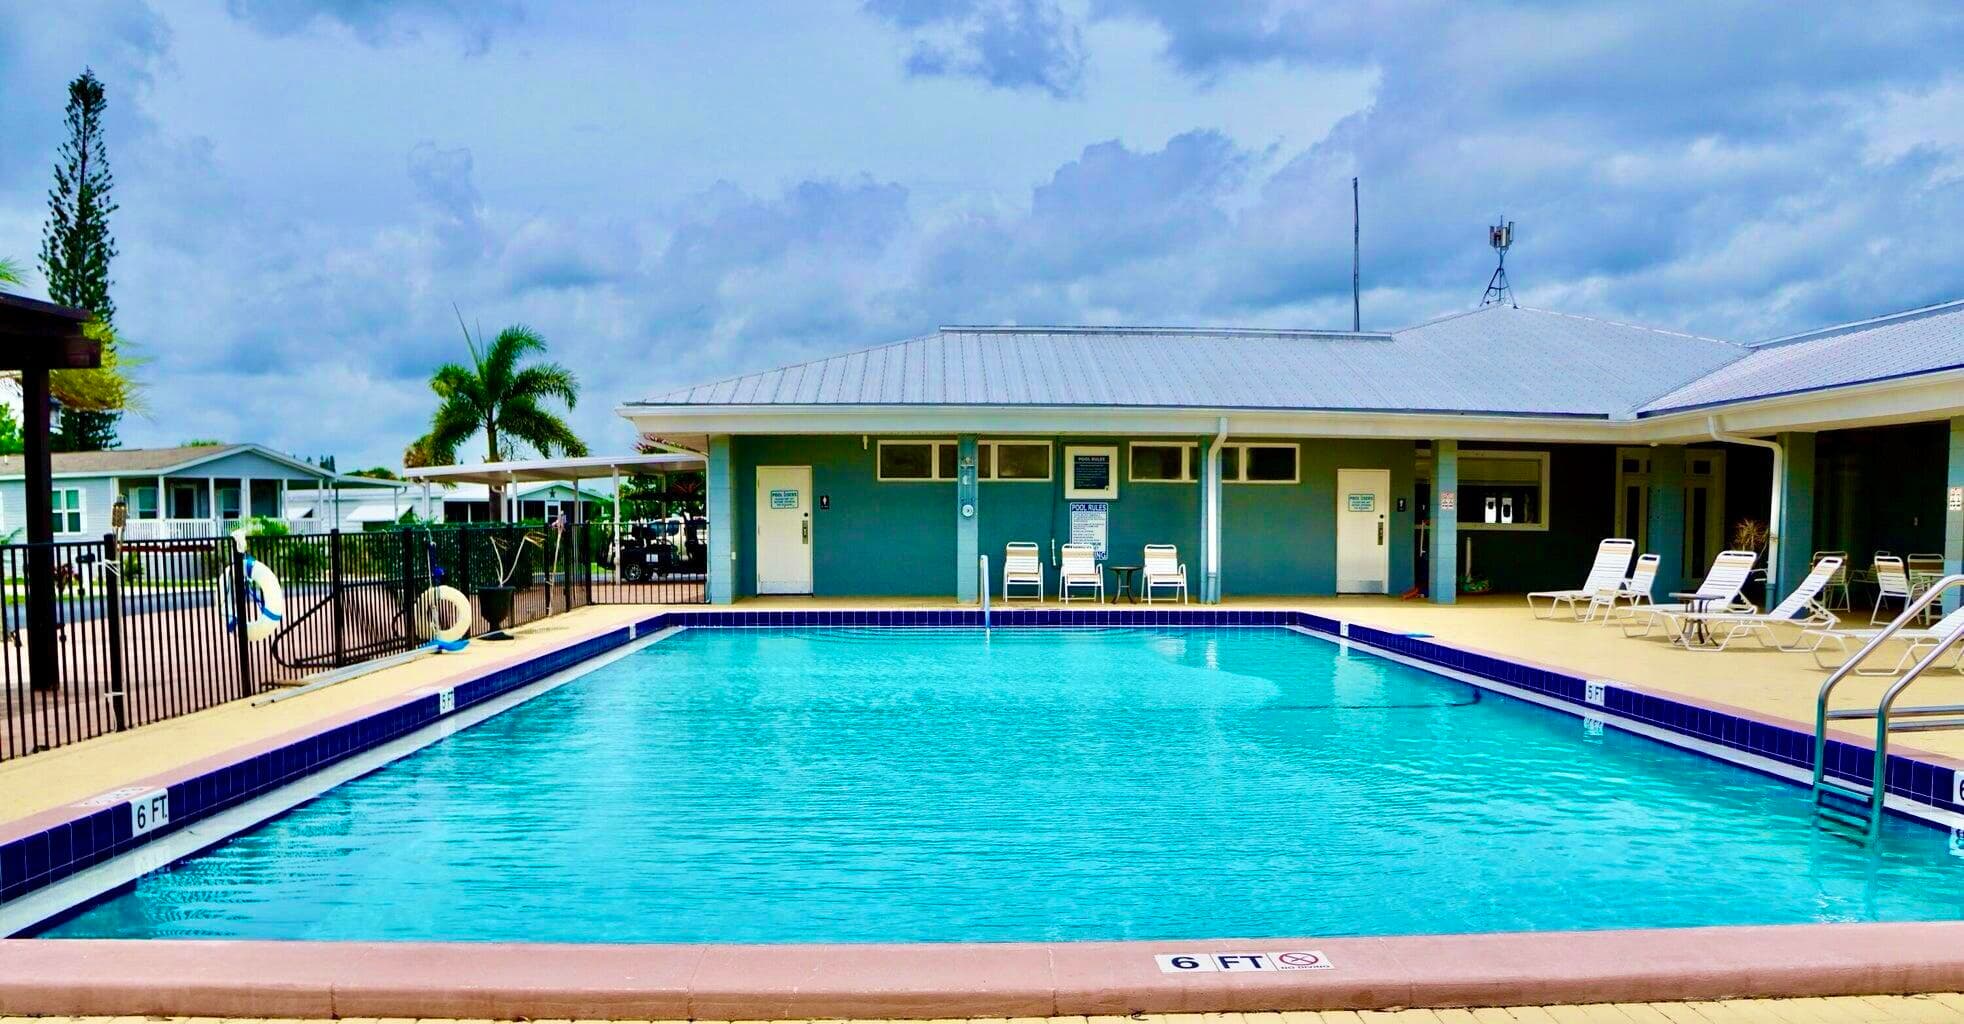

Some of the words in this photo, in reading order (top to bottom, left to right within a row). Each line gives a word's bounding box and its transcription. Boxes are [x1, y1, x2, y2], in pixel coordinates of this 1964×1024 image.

[1588, 685, 1592, 699] 5
[1595, 686, 1603, 702] FT
[137, 804, 146, 829] 6
[1171, 956, 1199, 969] 6
[1217, 955, 1263, 969] FT
